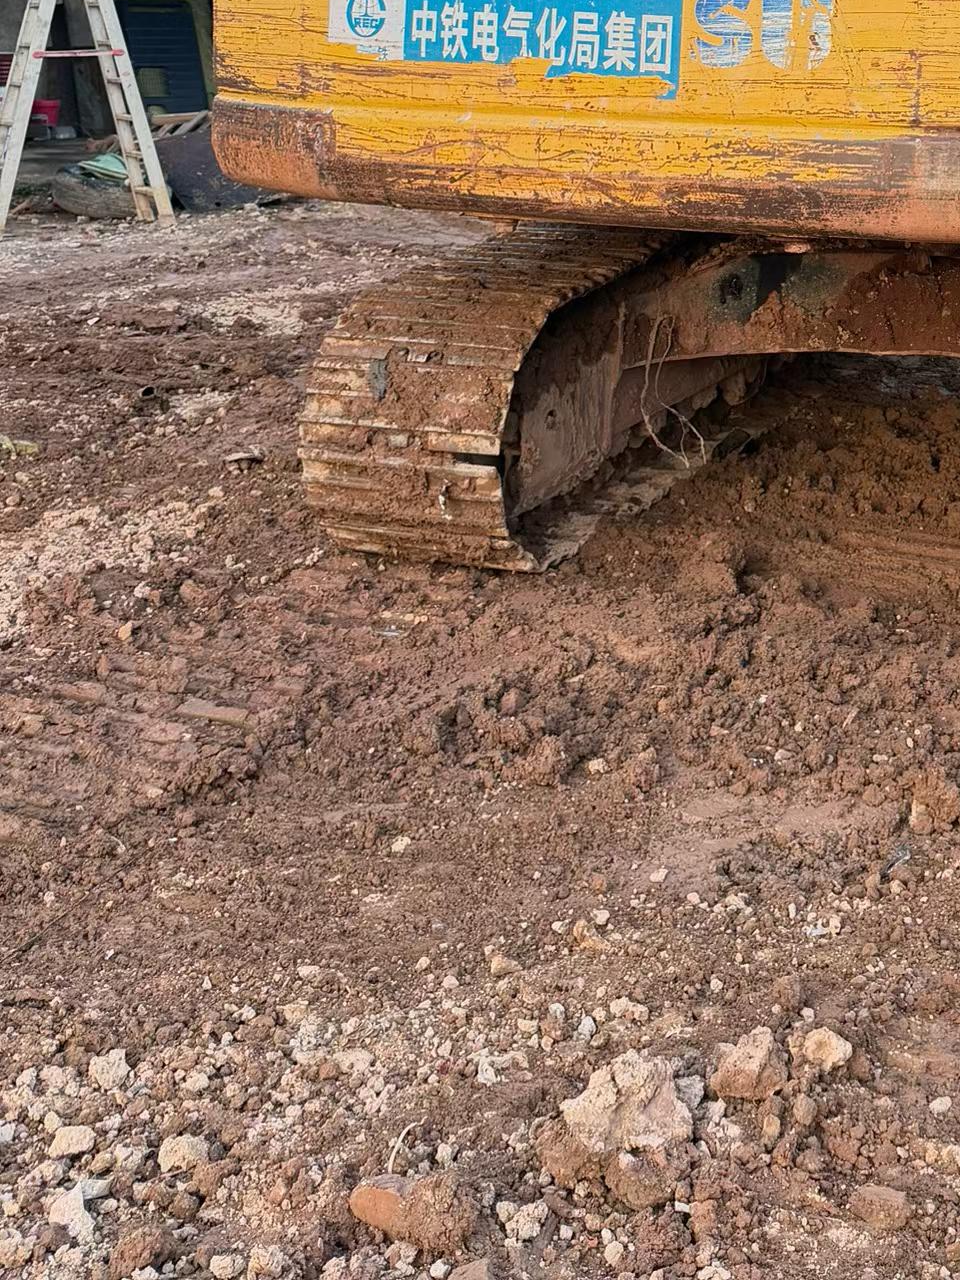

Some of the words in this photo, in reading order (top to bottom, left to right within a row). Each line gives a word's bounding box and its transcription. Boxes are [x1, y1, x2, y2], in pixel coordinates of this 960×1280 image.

[410, 0, 674, 74] 中铁电气化局集团
